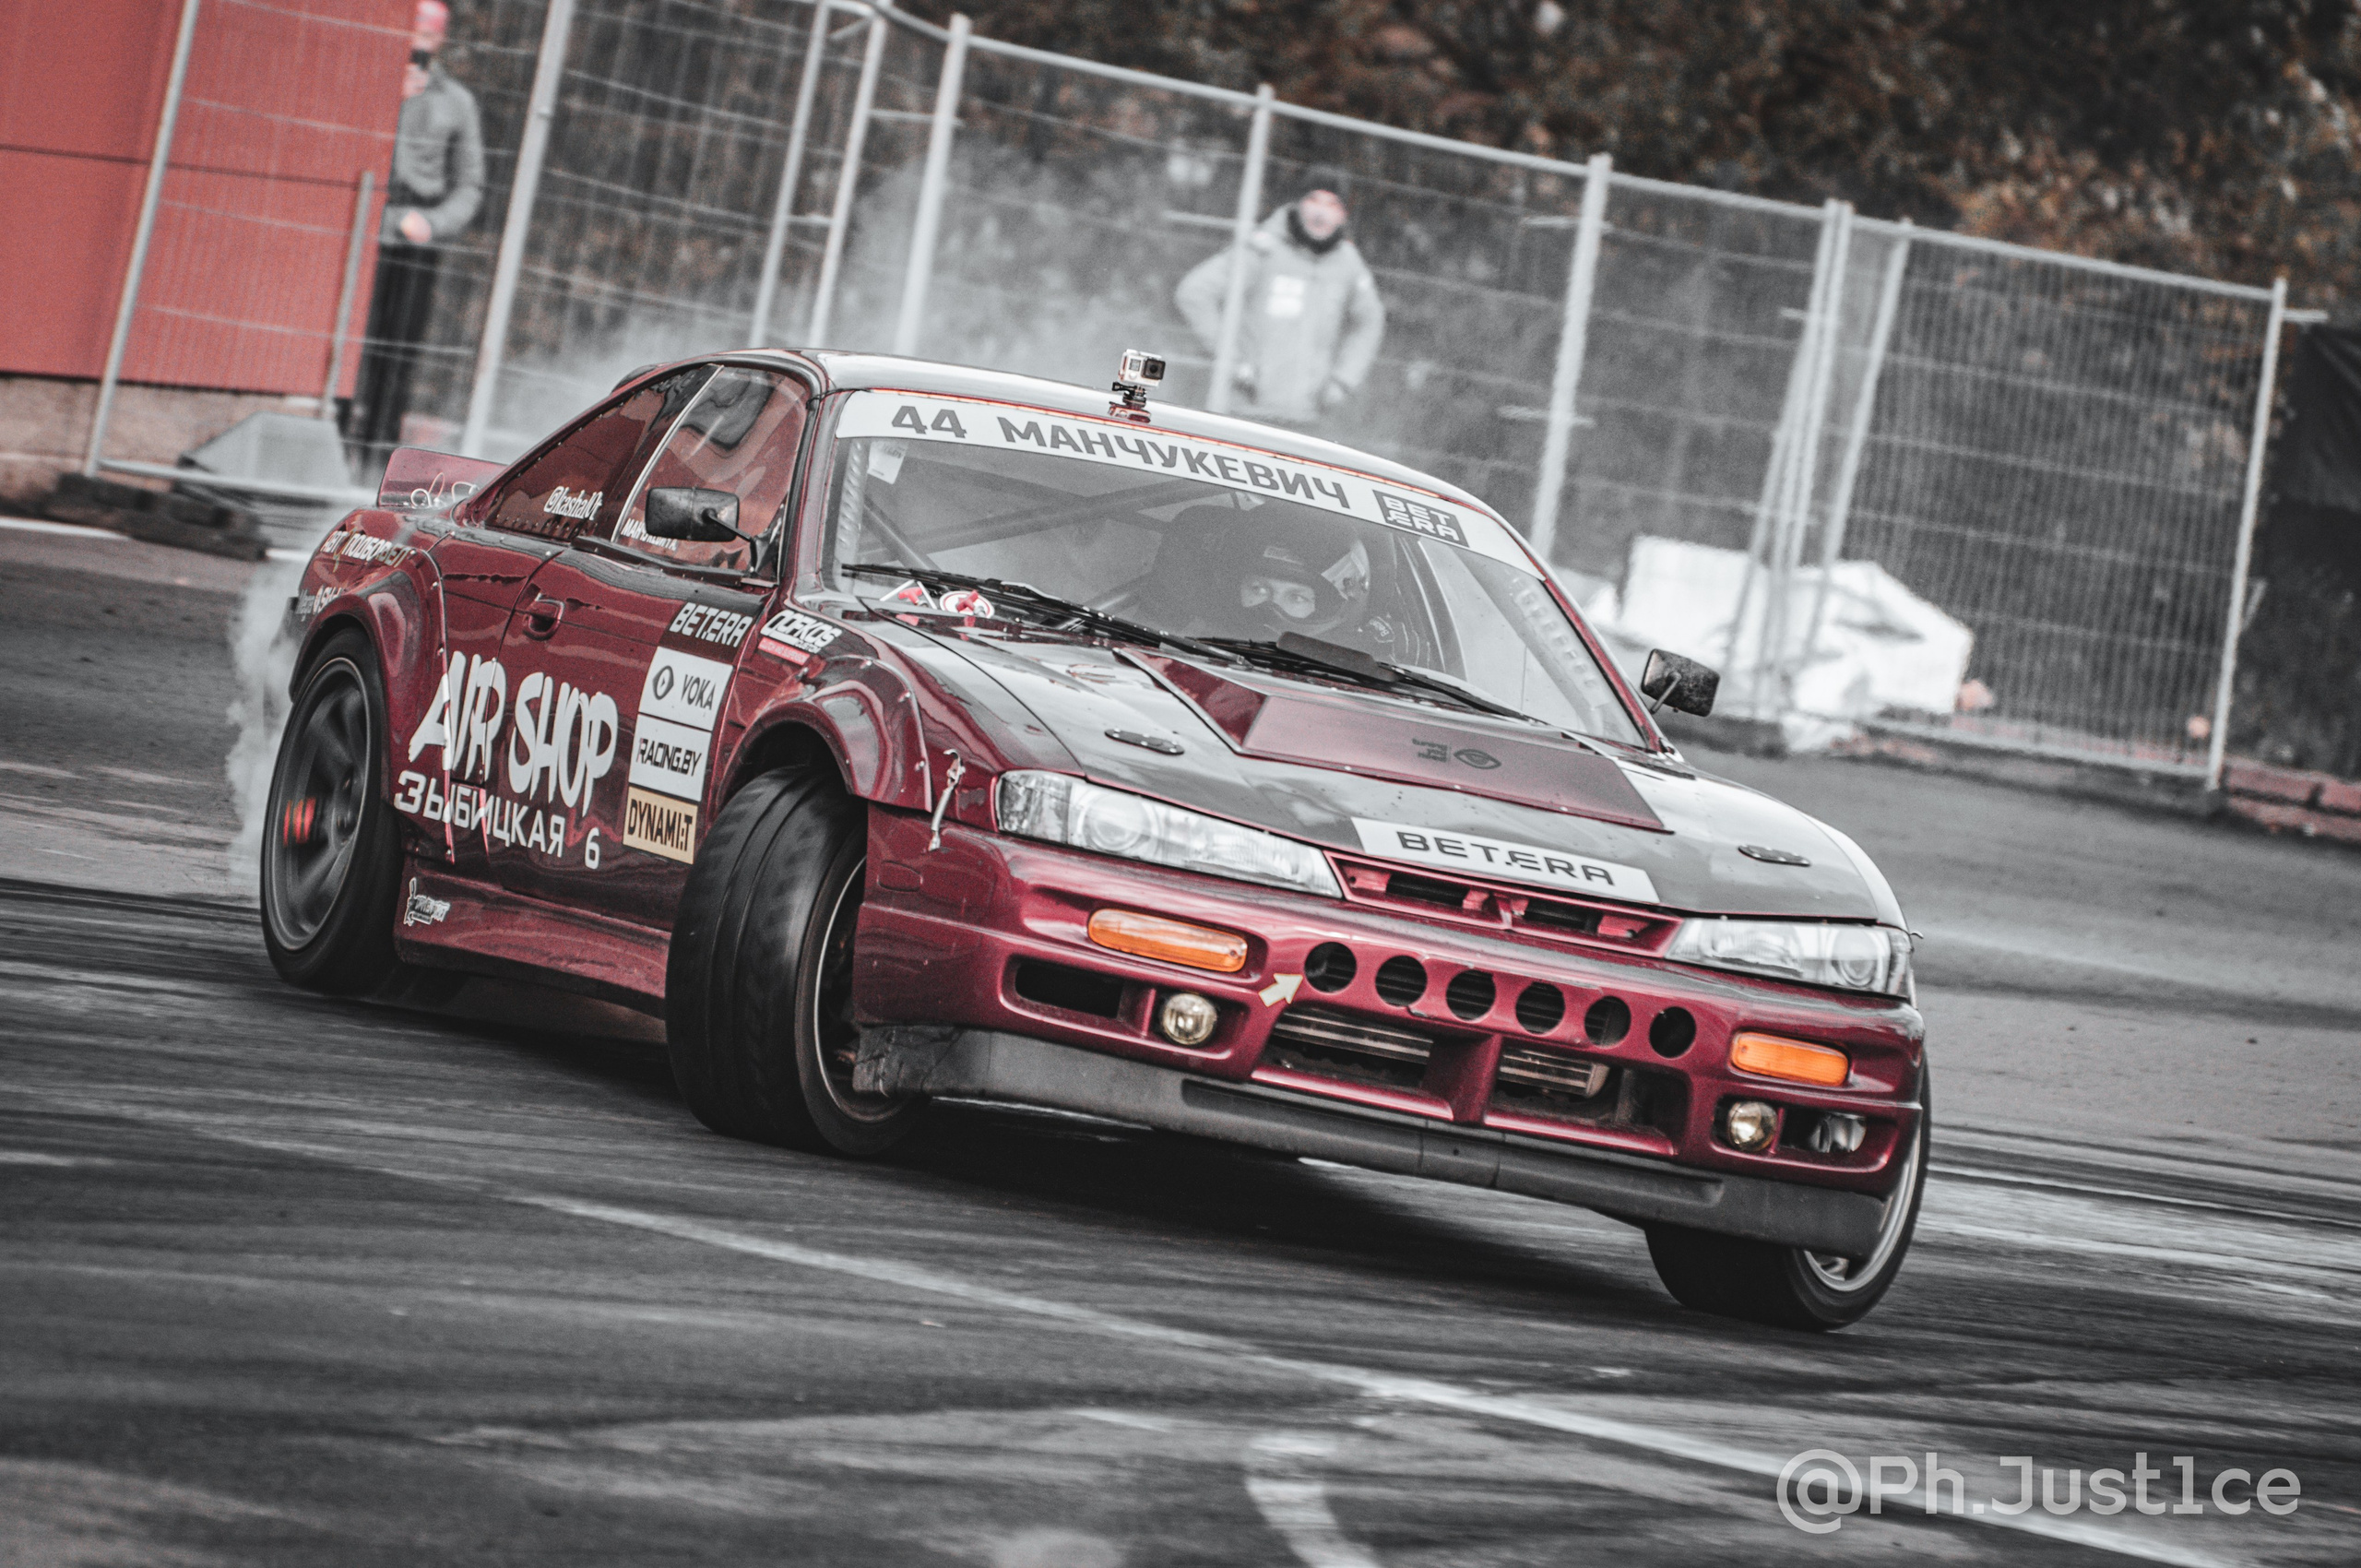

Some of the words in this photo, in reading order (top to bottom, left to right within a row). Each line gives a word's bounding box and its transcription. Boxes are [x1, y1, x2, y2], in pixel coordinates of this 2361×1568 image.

[892, 405, 967, 438] 44
[997, 416, 1350, 509] МАНЧУКЕВИЧ
[408, 650, 506, 781] AIR
[508, 671, 619, 818] SHOP
[681, 673, 717, 711] VOKA
[635, 738, 702, 777] RACING.BY
[394, 769, 565, 858] ЗЫБИЦКАЯ
[585, 827, 600, 870] 6
